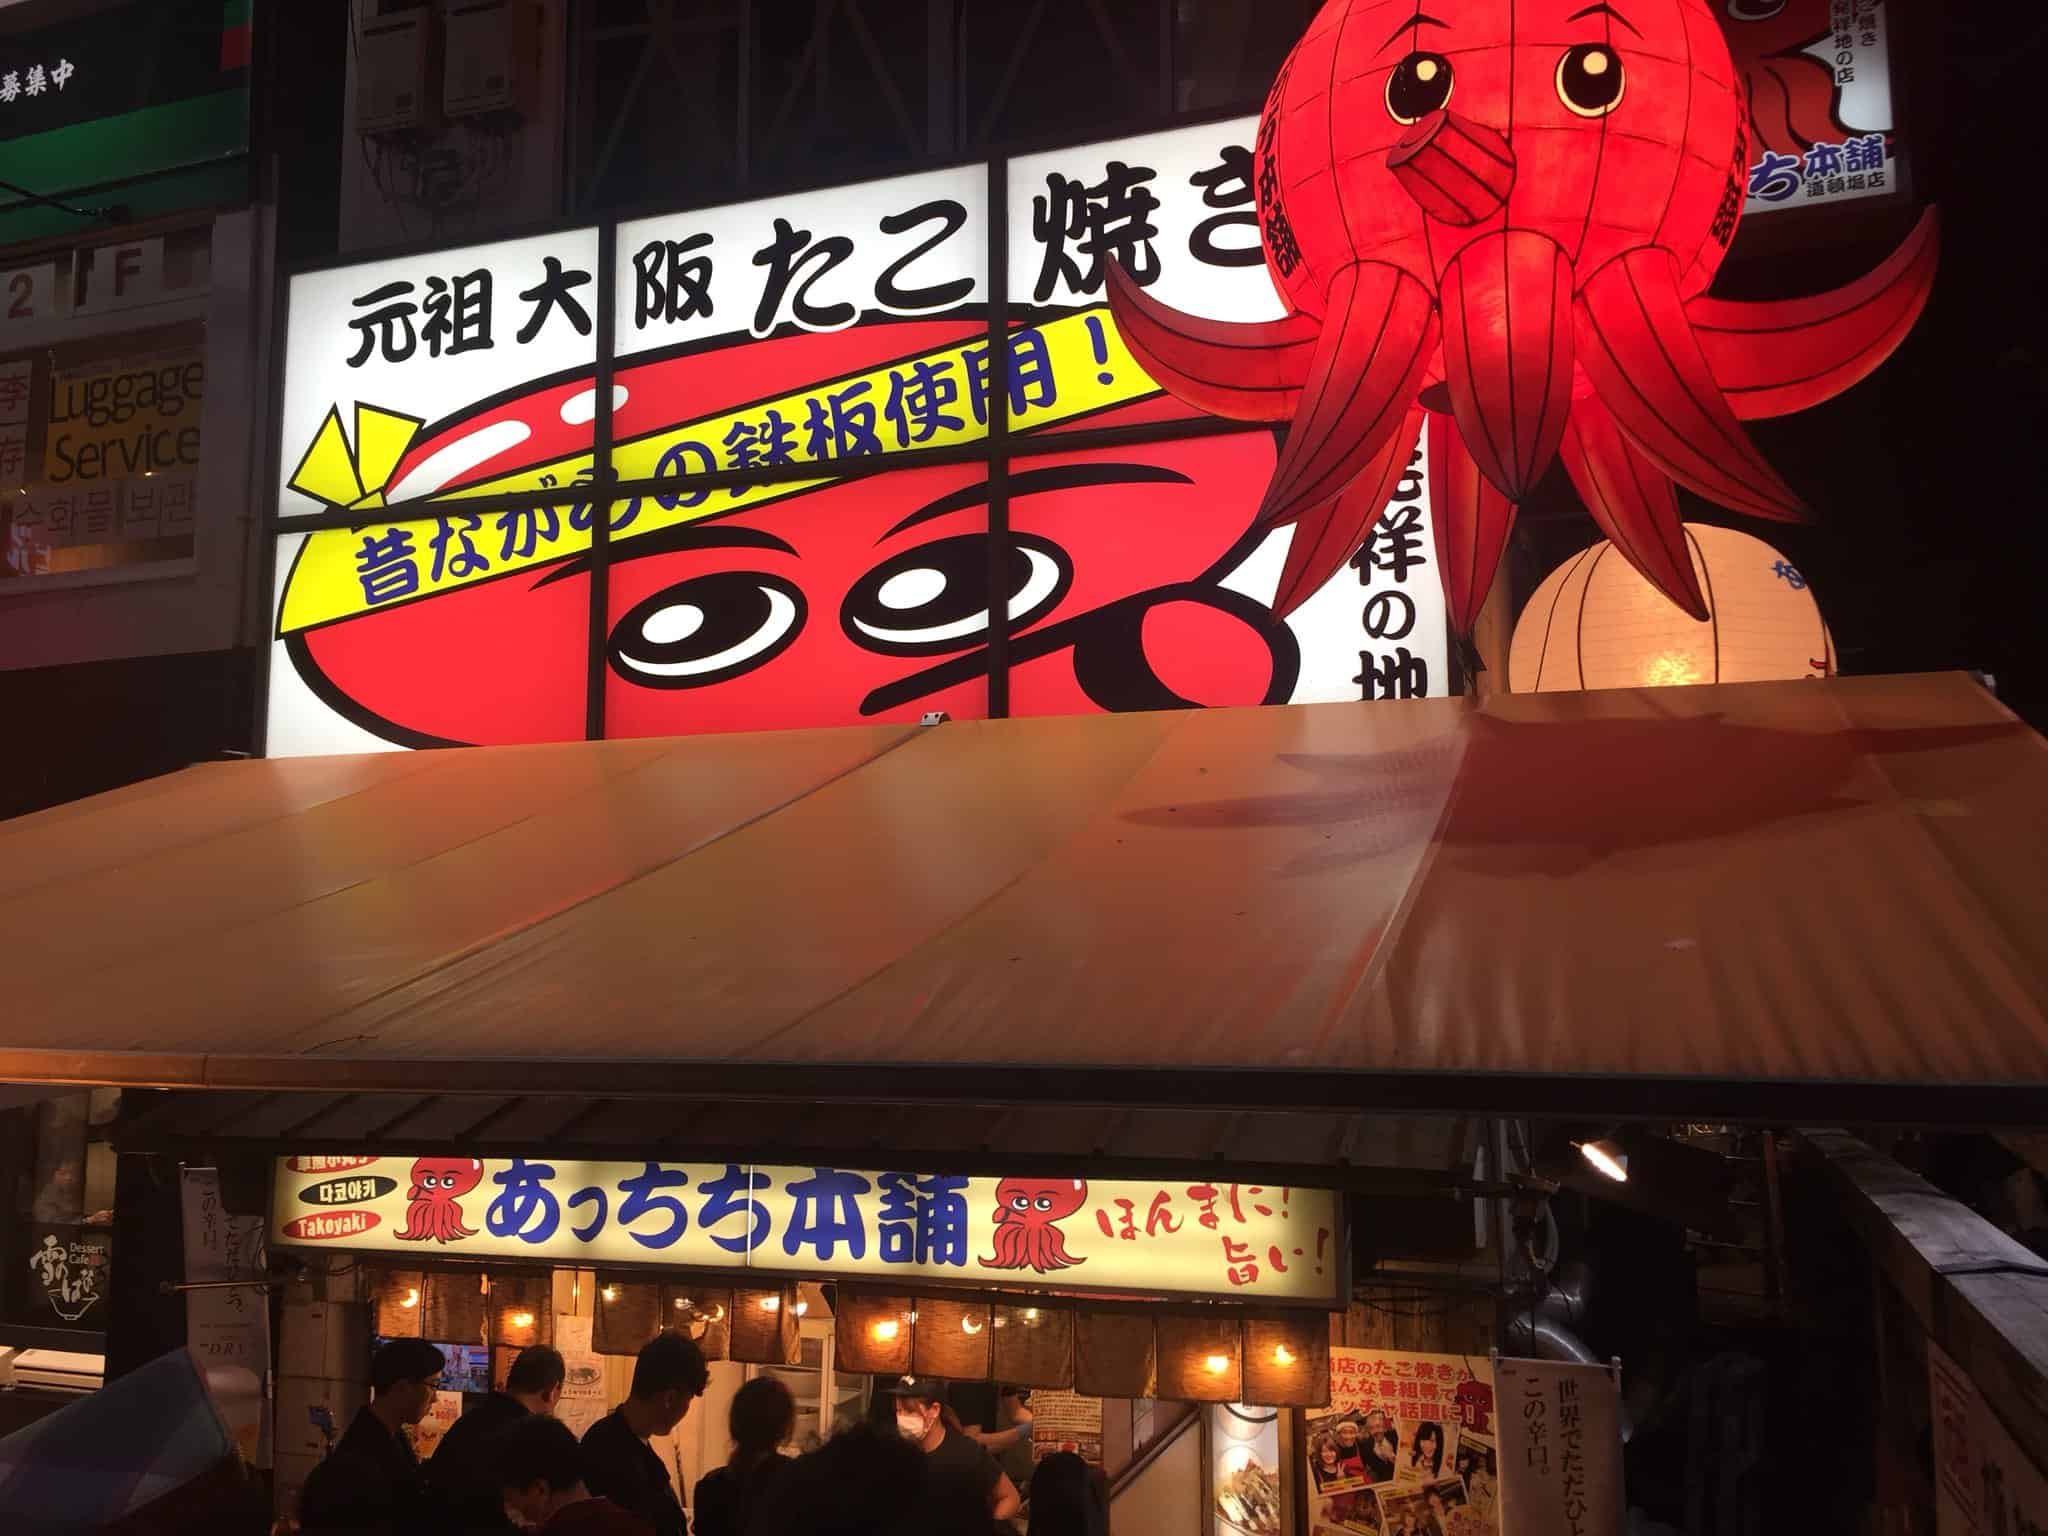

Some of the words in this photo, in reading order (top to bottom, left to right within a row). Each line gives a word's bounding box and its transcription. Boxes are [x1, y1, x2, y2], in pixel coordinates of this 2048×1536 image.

[346, 145, 1268, 369] 元祖大阪たこ焼き
[49, 361, 204, 427] Luggage
[50, 424, 201, 482] Service
[319, 1178, 377, 1204] 다코야키
[486, 1159, 969, 1267] あっちち本舗
[298, 1212, 367, 1237] Takoyaki
